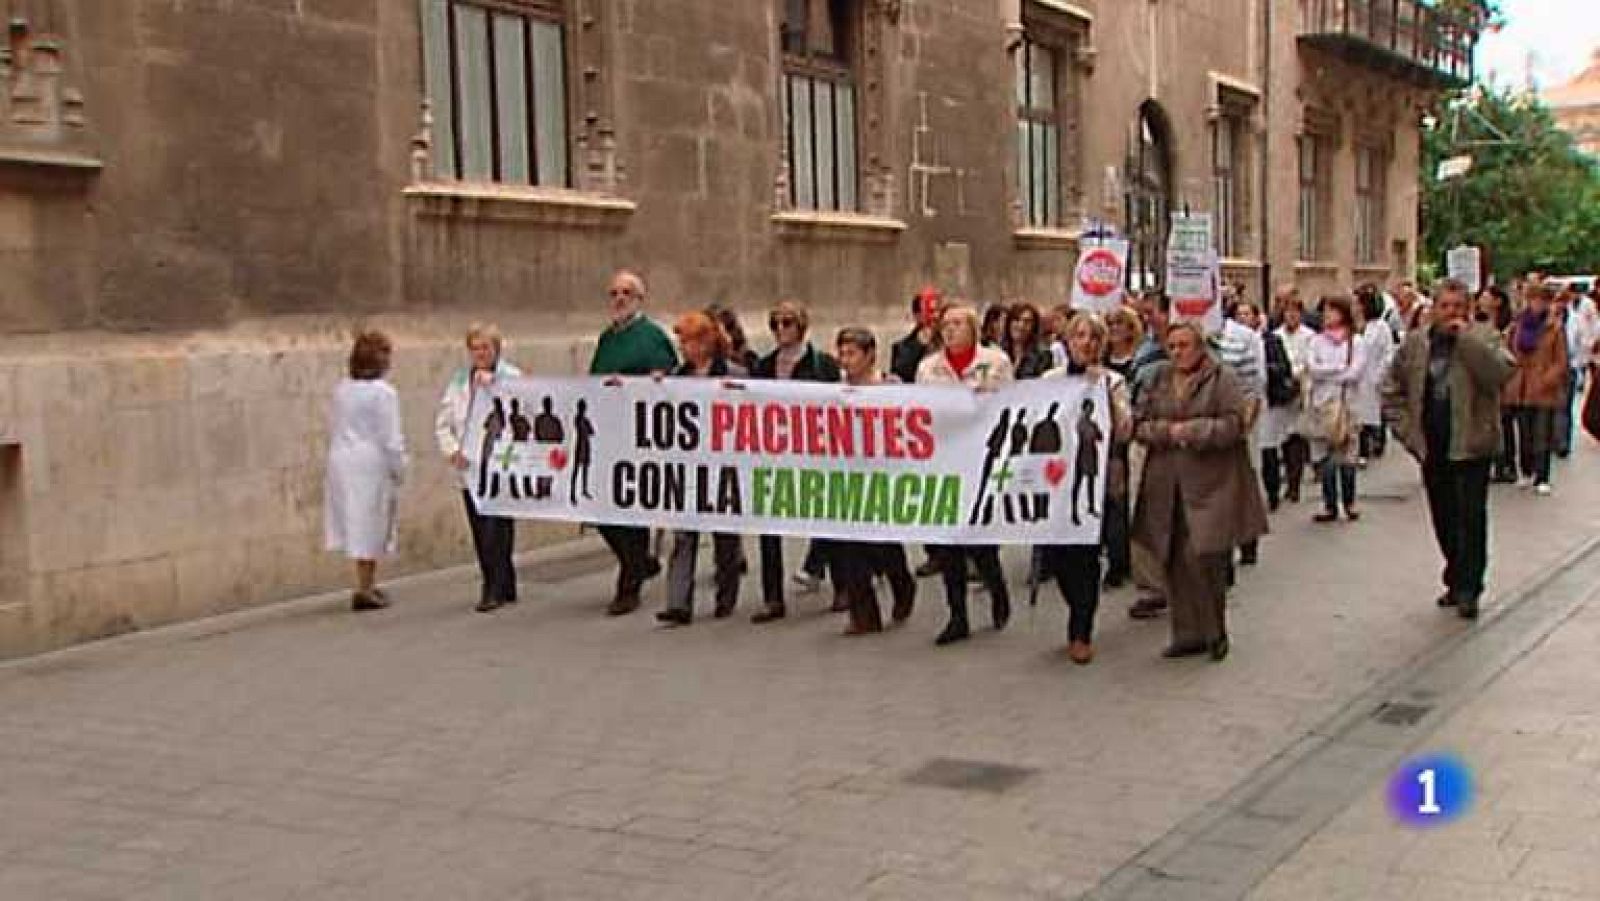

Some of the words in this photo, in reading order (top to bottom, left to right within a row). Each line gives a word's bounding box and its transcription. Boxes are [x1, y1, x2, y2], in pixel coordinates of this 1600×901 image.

[635, 400, 700, 452] LOS
[709, 401, 935, 460] PACIENTES
[612, 460, 685, 513] CON
[696, 465, 742, 515] LA
[752, 466, 961, 526] FARMACIA
